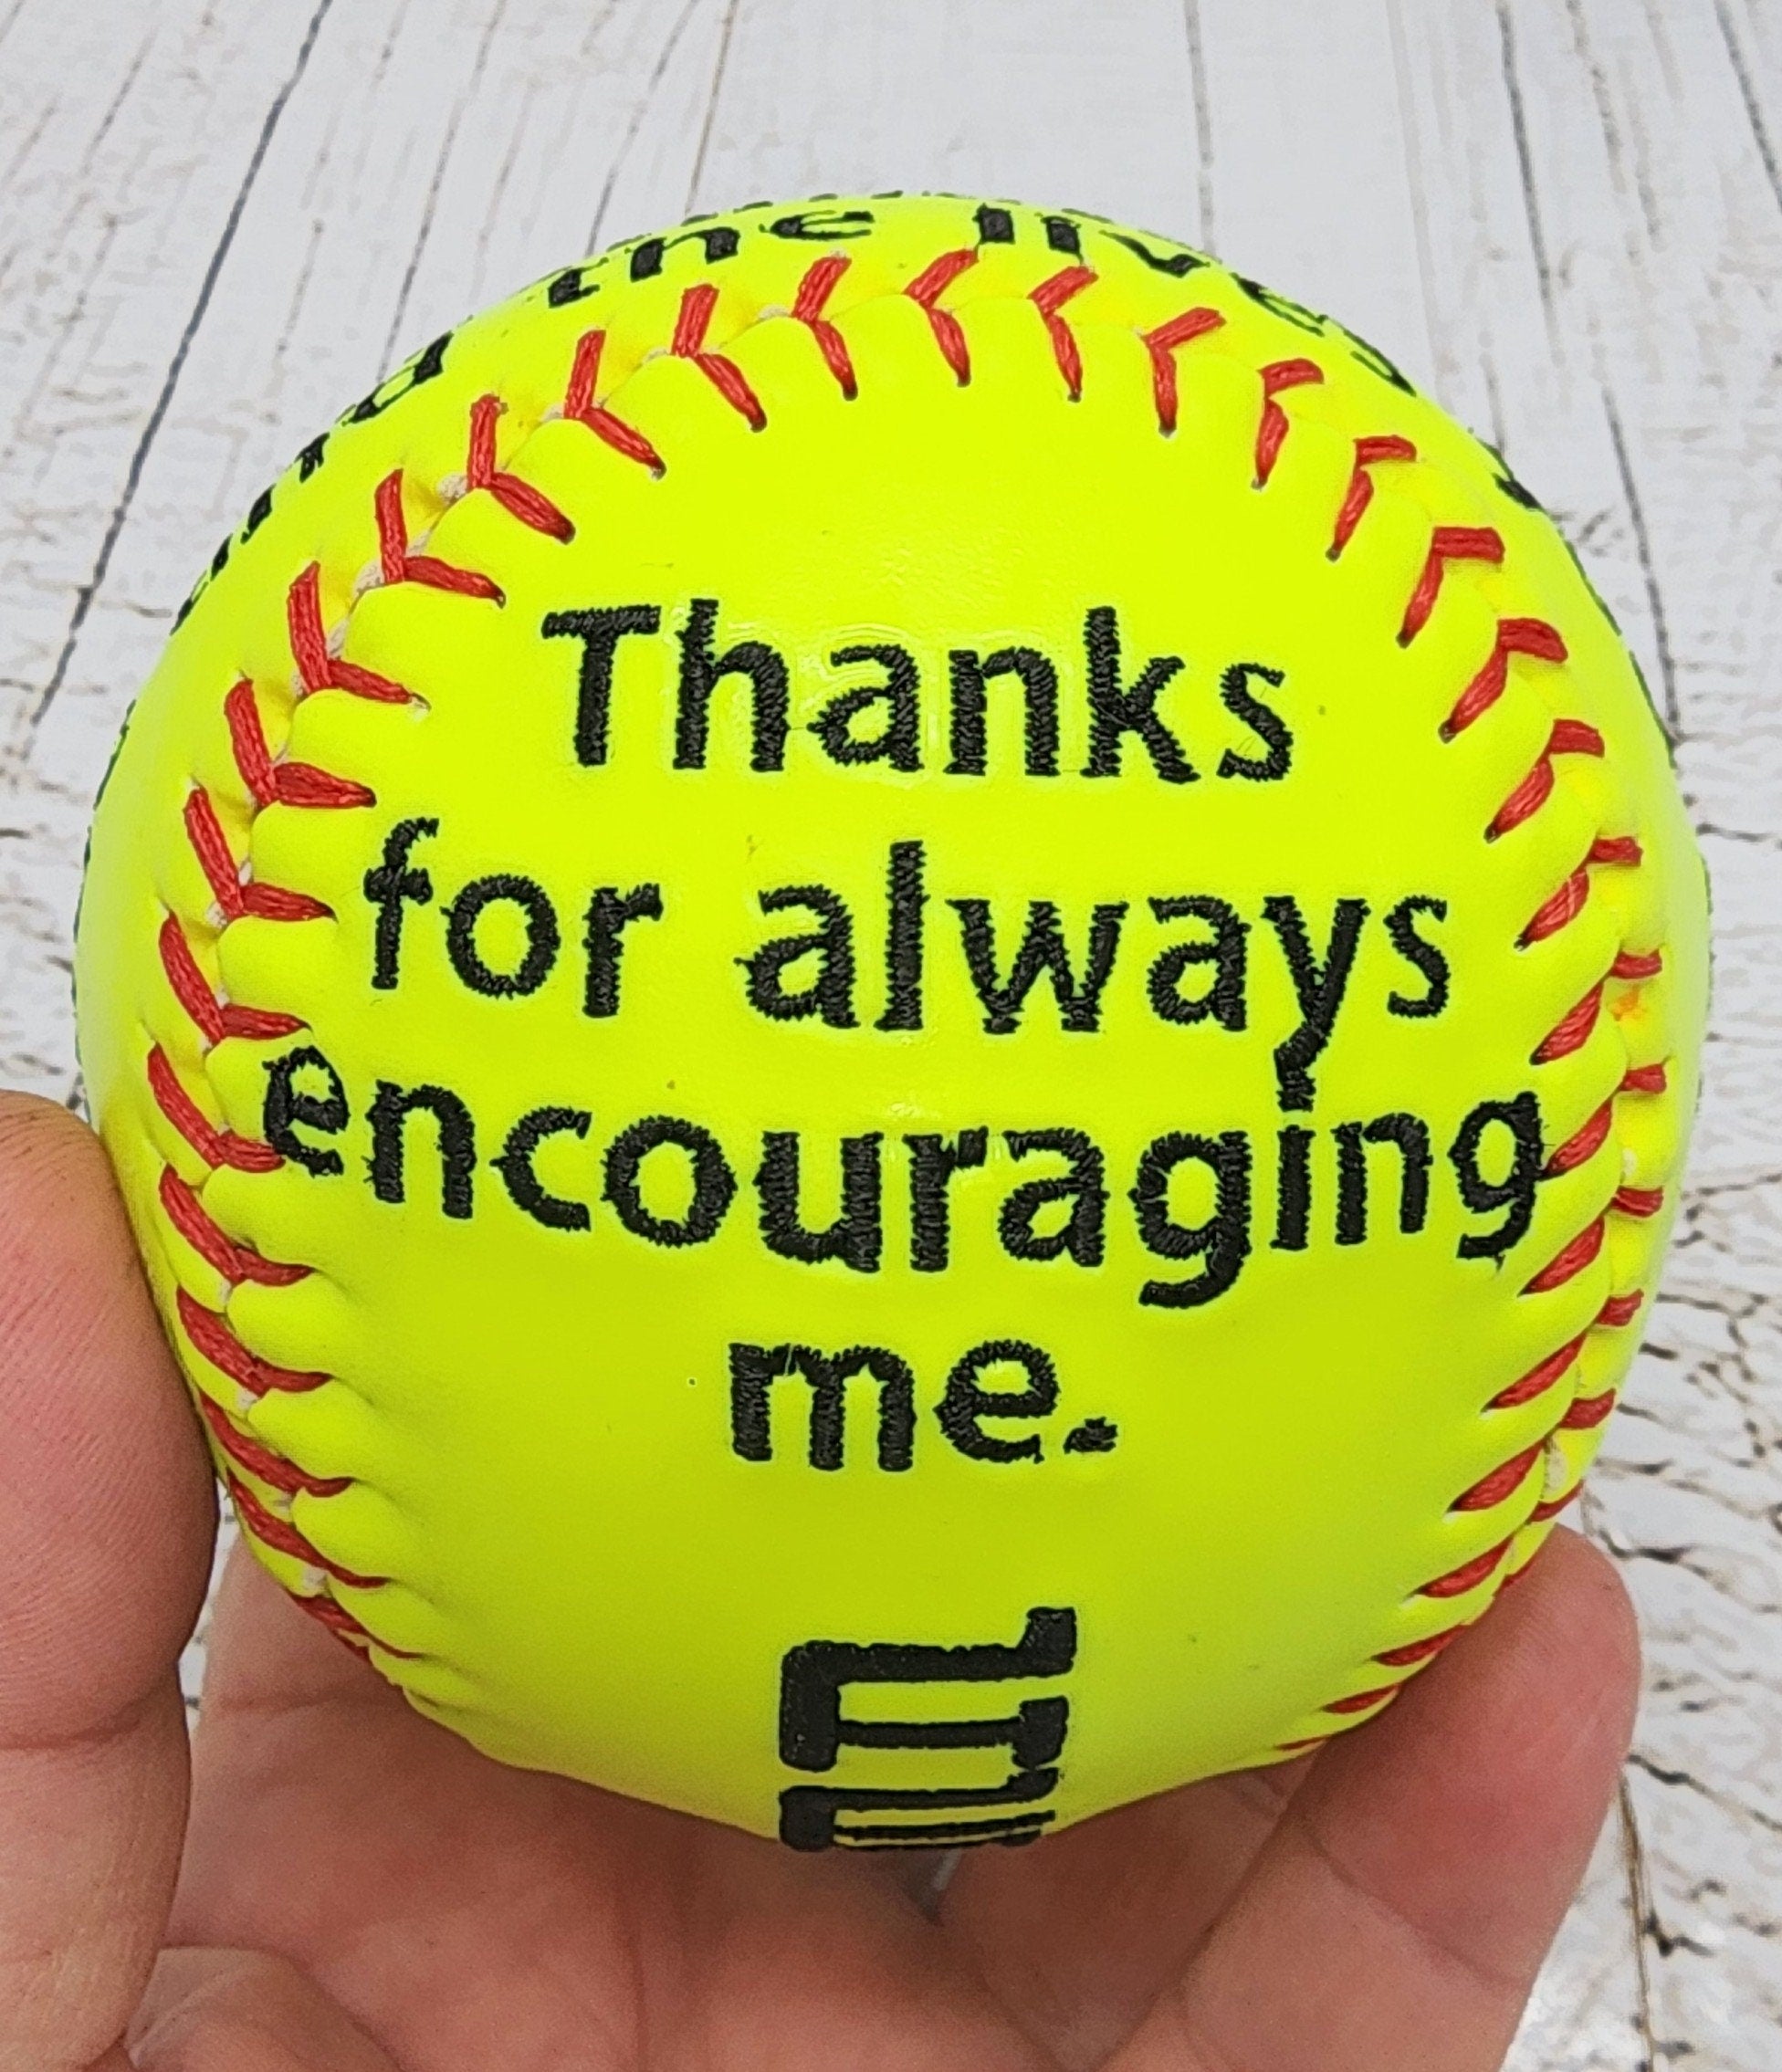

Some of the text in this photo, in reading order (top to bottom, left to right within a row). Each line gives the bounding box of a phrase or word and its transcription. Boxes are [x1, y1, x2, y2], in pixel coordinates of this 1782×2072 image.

[547, 210, 874, 309] the
[971, 203, 1417, 395] lives
[540, 598, 1294, 785] Thanks
[363, 817, 1452, 1073] for always
[262, 1044, 1543, 1310] encouraging
[729, 1339, 1118, 1472] me.
